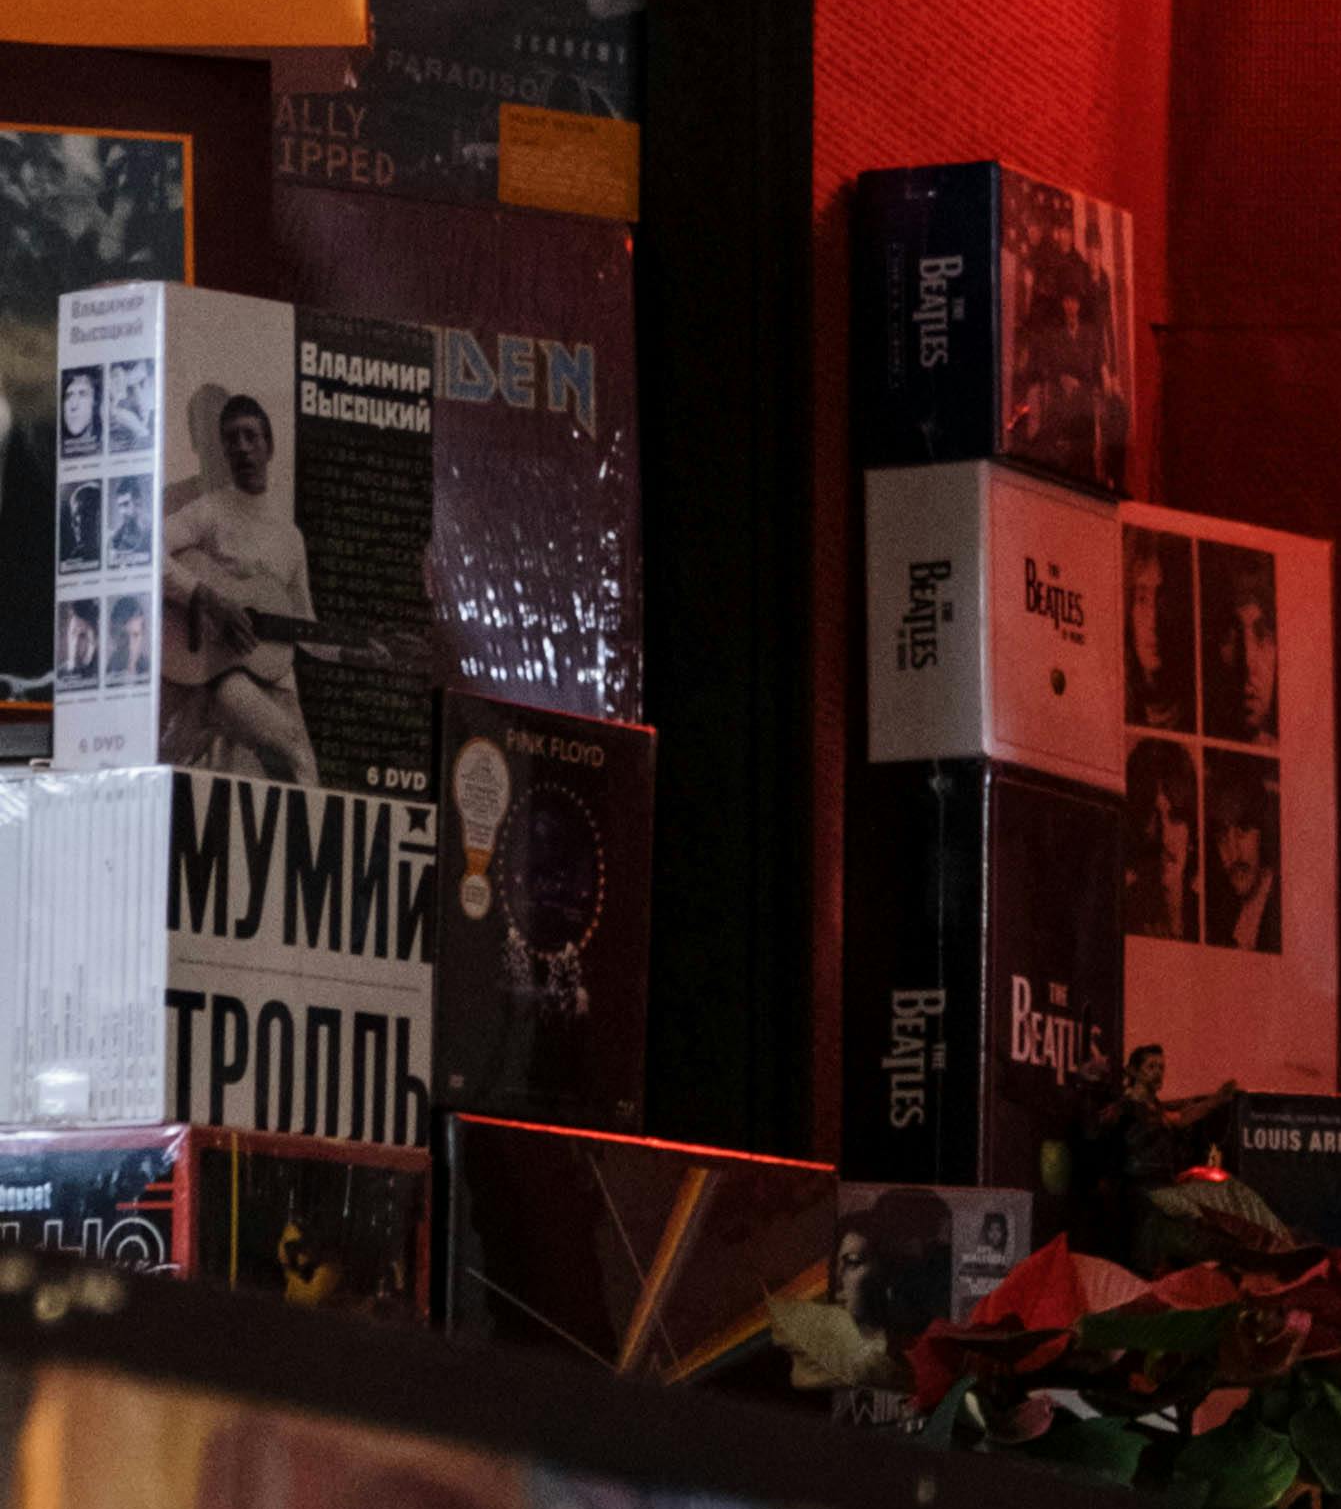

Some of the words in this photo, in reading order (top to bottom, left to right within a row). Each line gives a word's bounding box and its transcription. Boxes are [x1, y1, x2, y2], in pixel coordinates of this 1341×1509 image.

[274, 94, 367, 141] ALLY
[276, 135, 398, 188] IPPED
[505, 727, 546, 758] PINK
[549, 736, 605, 769] FLOYD
[364, 764, 381, 787] 6
[384, 766, 429, 793] DVD
[166, 772, 436, 962] МУМИЙ
[881, 988, 947, 1129] BEATLES
[1242, 1126, 1302, 1152] LOUIS
